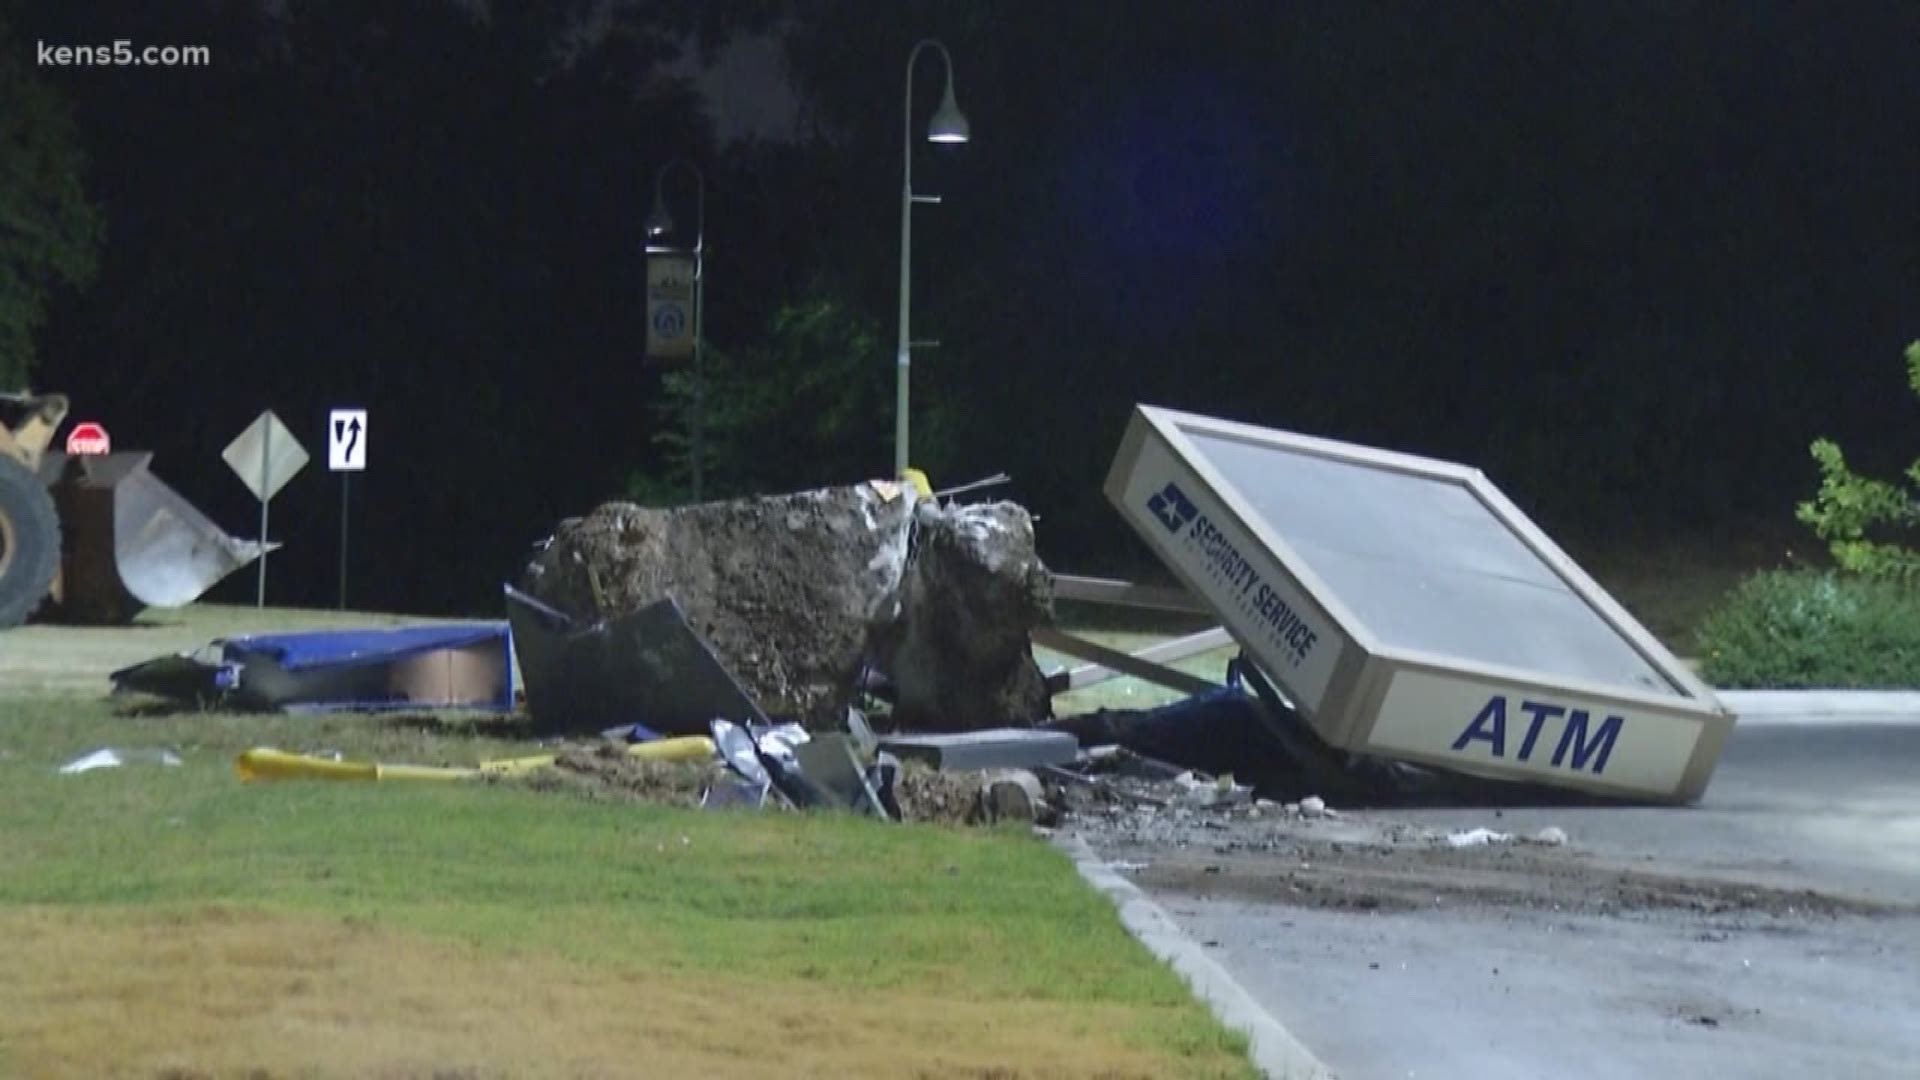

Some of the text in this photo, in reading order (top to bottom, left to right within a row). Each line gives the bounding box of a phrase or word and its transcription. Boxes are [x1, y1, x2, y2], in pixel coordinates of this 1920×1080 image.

[1190, 516, 1260, 595] SECURITY
[1253, 583, 1317, 660] SERVICE
[1452, 696, 1625, 774] ATM
